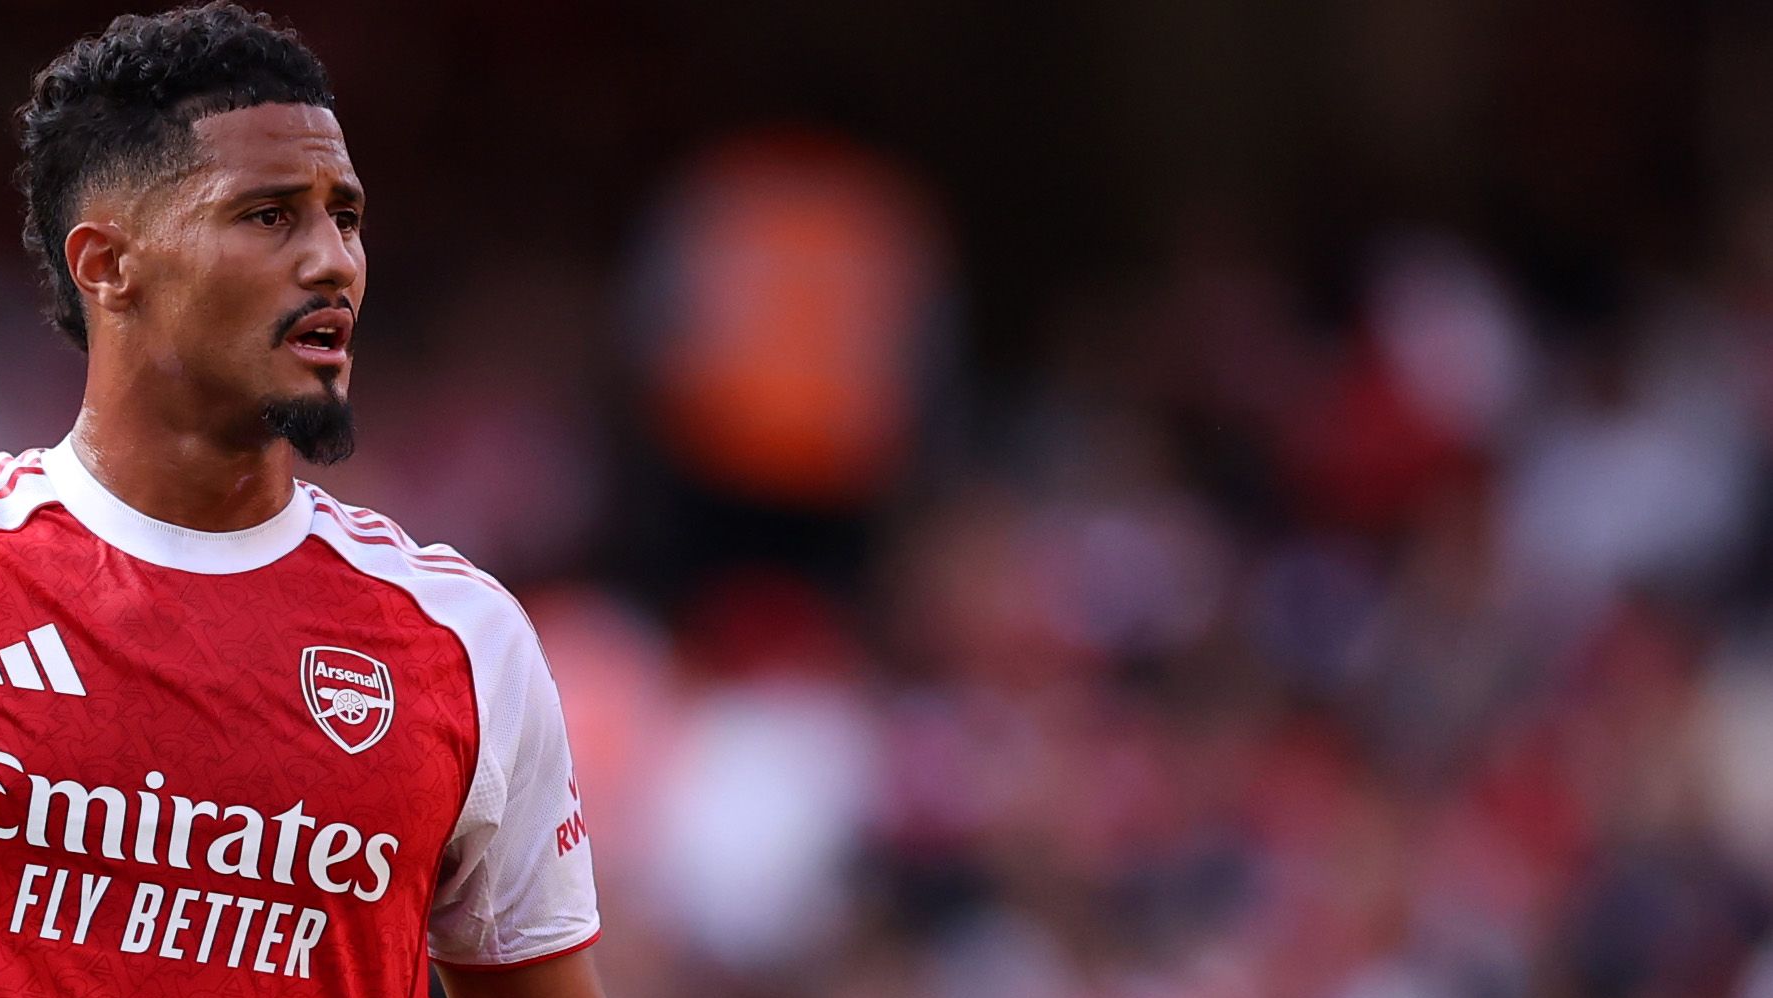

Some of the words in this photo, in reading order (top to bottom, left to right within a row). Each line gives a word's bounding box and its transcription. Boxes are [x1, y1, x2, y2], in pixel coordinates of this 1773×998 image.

[315, 661, 380, 689] Arsenal
[9, 863, 112, 945] FLY
[120, 882, 327, 979] BETTER
